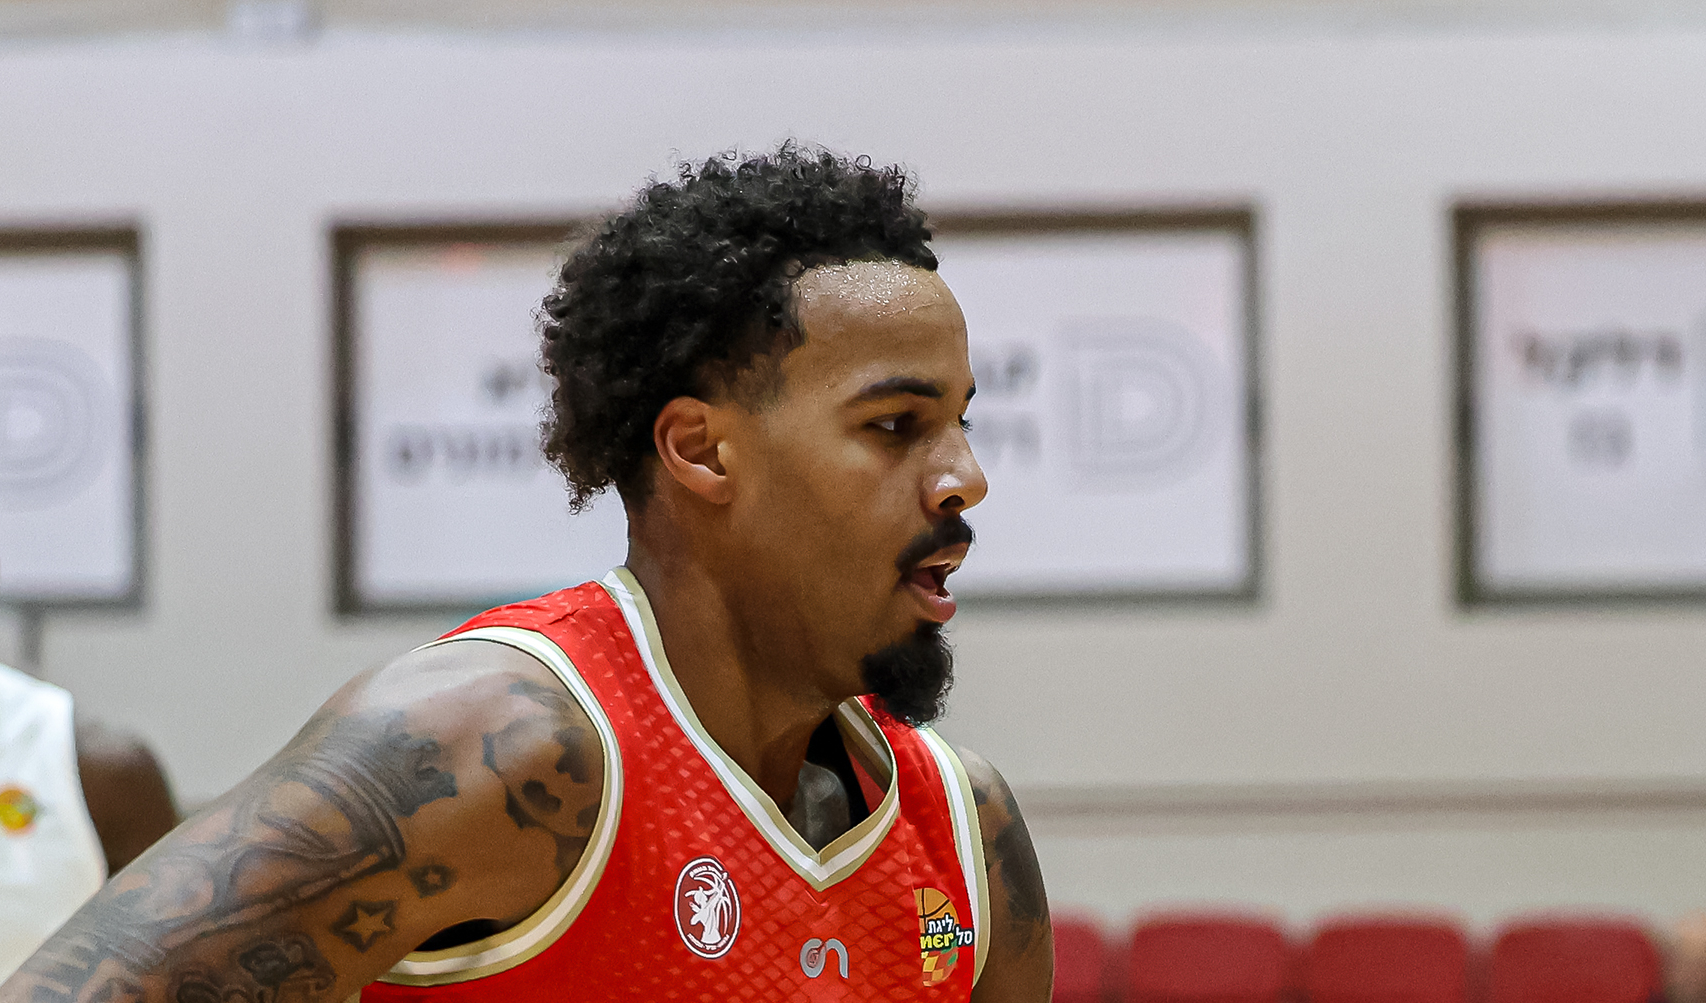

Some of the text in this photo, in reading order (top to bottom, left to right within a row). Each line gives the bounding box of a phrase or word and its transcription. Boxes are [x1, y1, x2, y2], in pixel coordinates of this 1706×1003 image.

[928, 914, 954, 933] ליגת
[920, 926, 973, 949] ner סל
